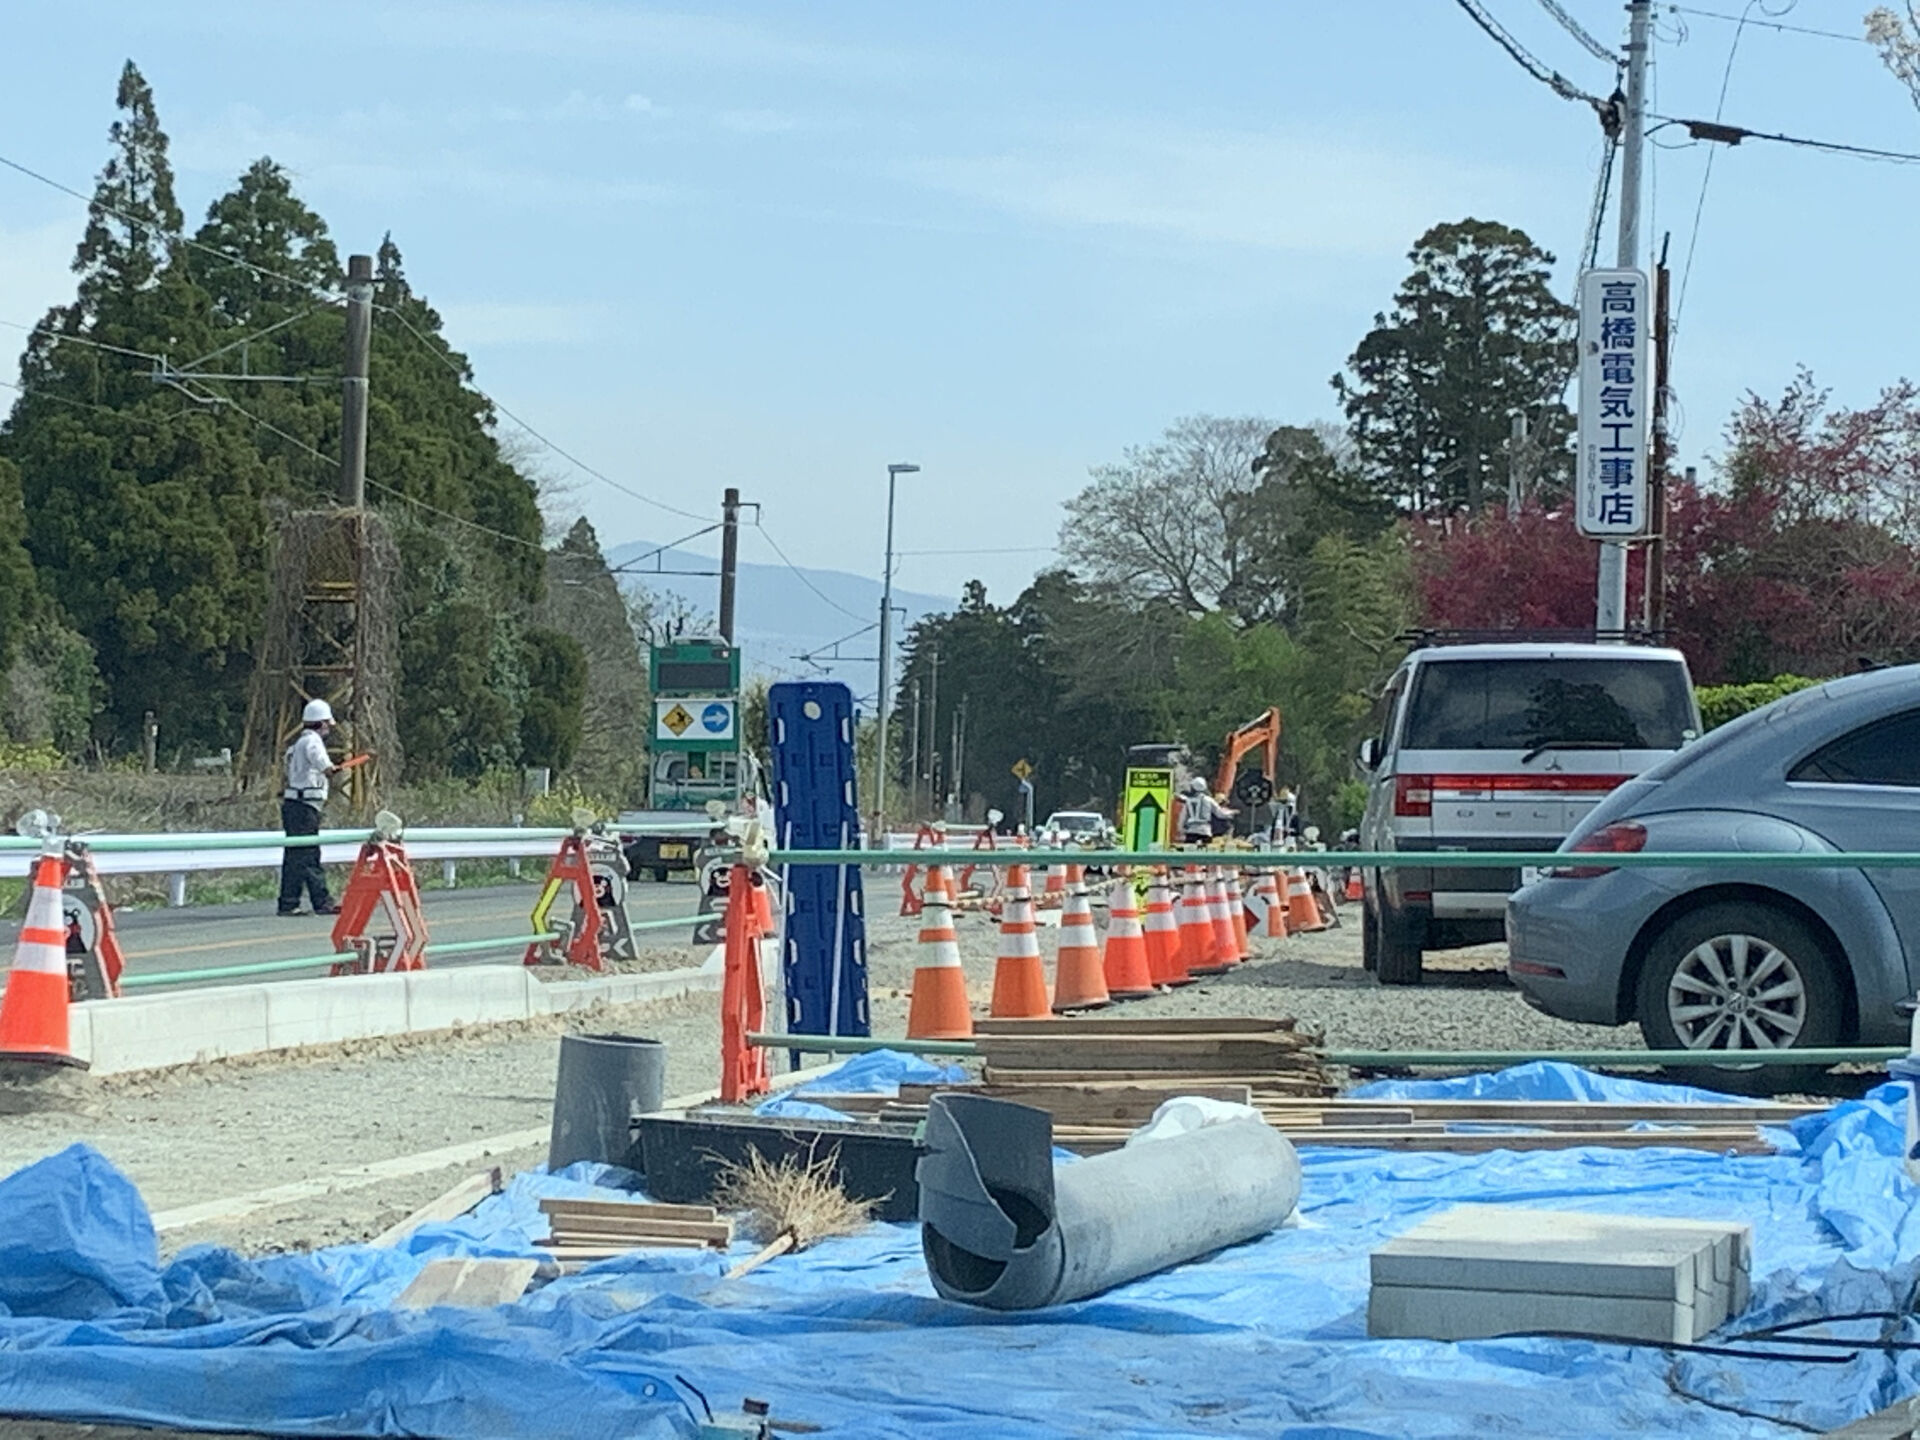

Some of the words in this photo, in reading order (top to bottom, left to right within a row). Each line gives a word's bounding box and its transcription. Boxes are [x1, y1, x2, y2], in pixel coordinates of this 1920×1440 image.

[1599, 281, 1636, 525] 高橋電気工事店
